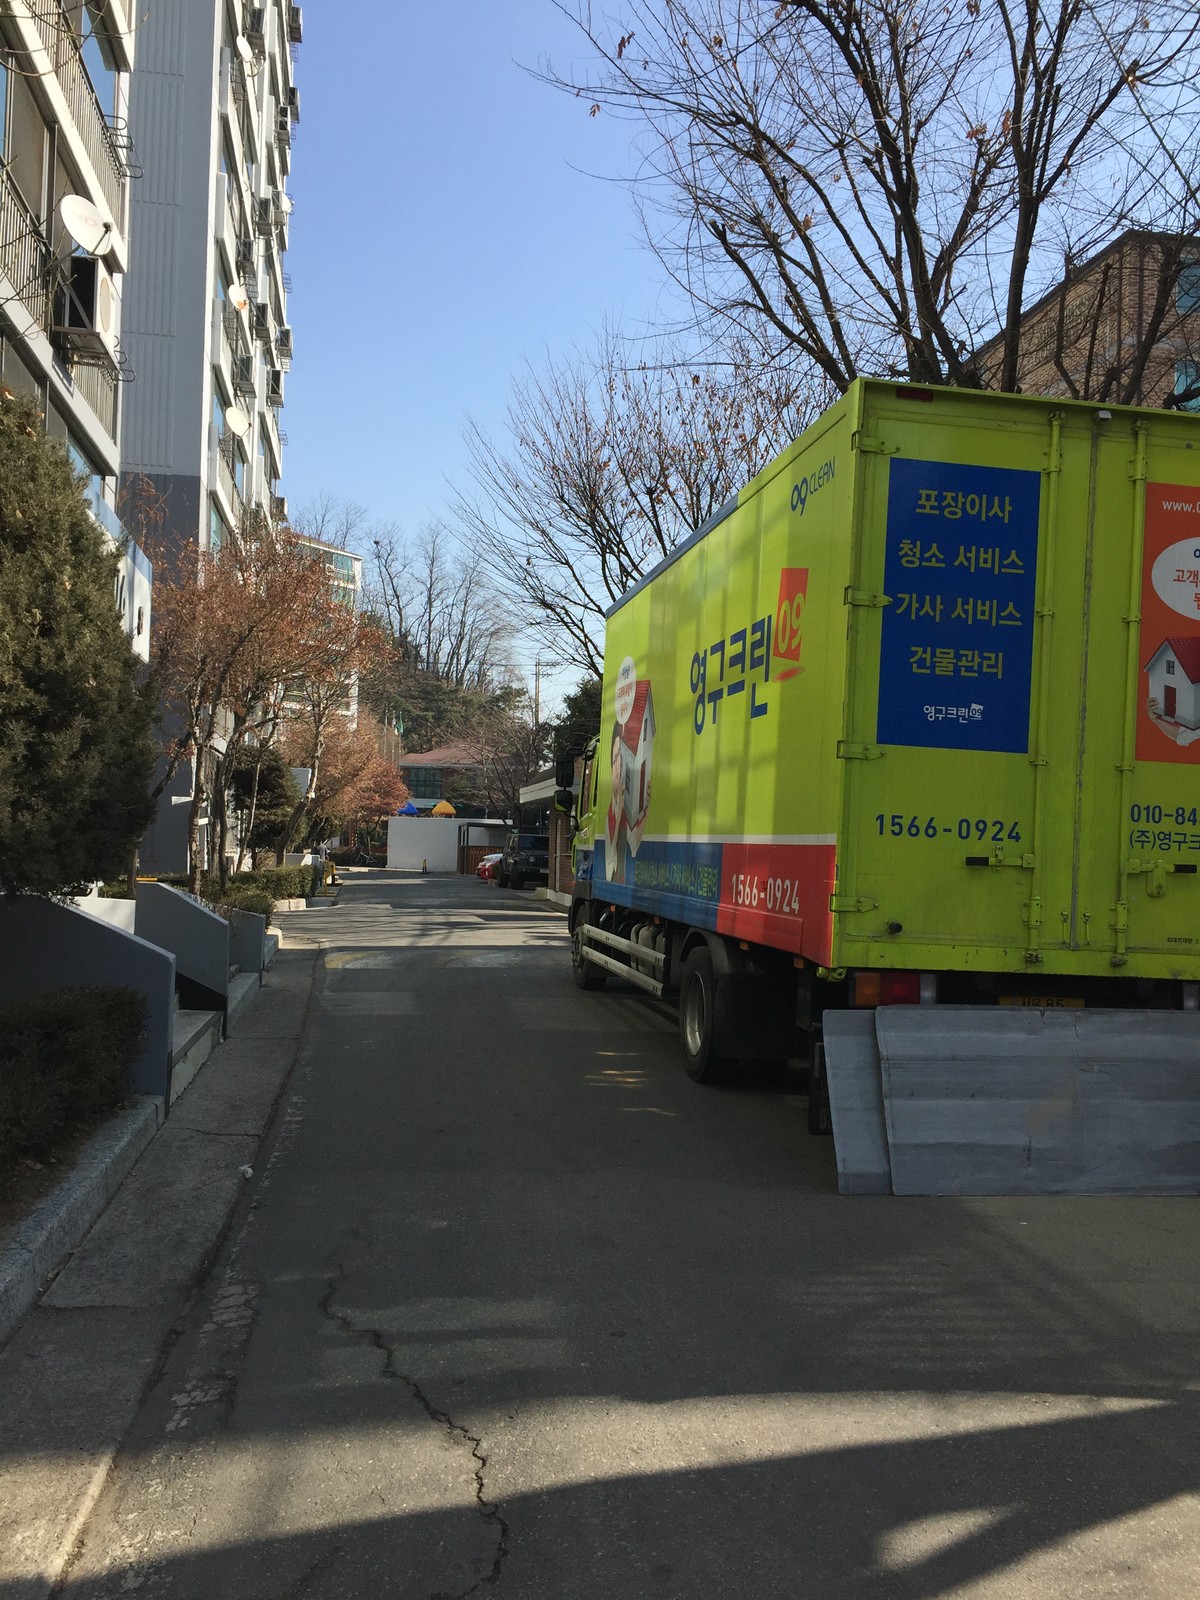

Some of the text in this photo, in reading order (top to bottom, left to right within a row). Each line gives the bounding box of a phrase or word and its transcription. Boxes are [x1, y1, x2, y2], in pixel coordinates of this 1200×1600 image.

[790, 455, 836, 516] 09 CLEAN
[915, 489, 1012, 523] 포장이사
[898, 540, 1025, 574] 청소 서비스
[1172, 569, 1200, 588] 고객
[895, 593, 1022, 627] 가사 서비스
[690, 614, 773, 735] 영구크린
[908, 646, 1003, 679] 건물관리
[875, 814, 1021, 843] 1566-0924
[1130, 804, 1200, 826] 010-84
[731, 873, 800, 914] 1566-0924
